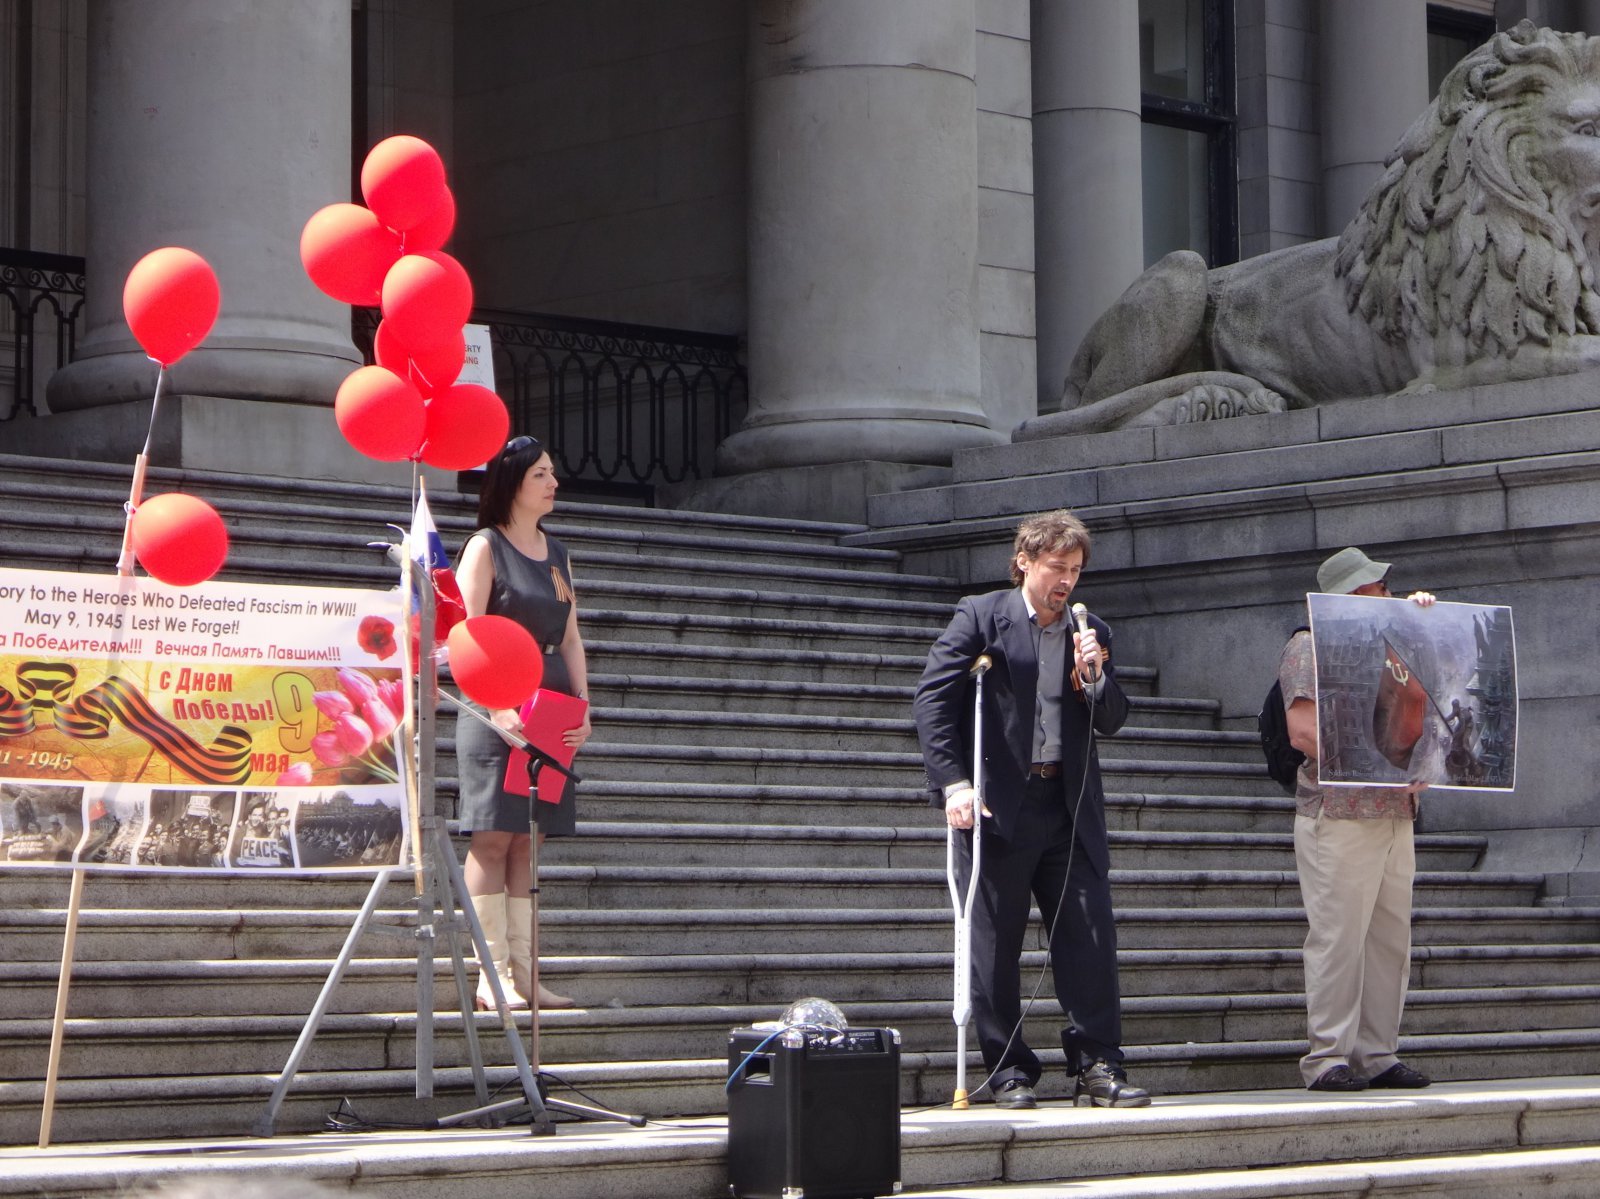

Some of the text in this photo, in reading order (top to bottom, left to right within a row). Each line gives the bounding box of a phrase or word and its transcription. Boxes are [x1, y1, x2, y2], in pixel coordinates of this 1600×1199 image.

[30, 584, 46, 601] to
[52, 586, 77, 603] the
[83, 588, 137, 607] Heroes
[142, 591, 175, 609] Who
[179, 594, 246, 613] Defeated
[250, 598, 303, 615] Fascism
[306, 600, 318, 616] in
[322, 601, 357, 618] WWII!
[24, 608, 240, 638] May 9, 1945 Lest We Forget!
[12, 631, 143, 655] Победителям!!!
[155, 639, 208, 657] Вечная
[211, 642, 264, 659] Память
[267, 644, 342, 661] Павшим!!!
[175, 667, 233, 695] Днем
[172, 698, 274, 724] Победы!
[271, 671, 319, 754] 9
[26, 750, 75, 772] 1945
[249, 752, 290, 773] мая
[242, 838, 279, 859] PEACE
